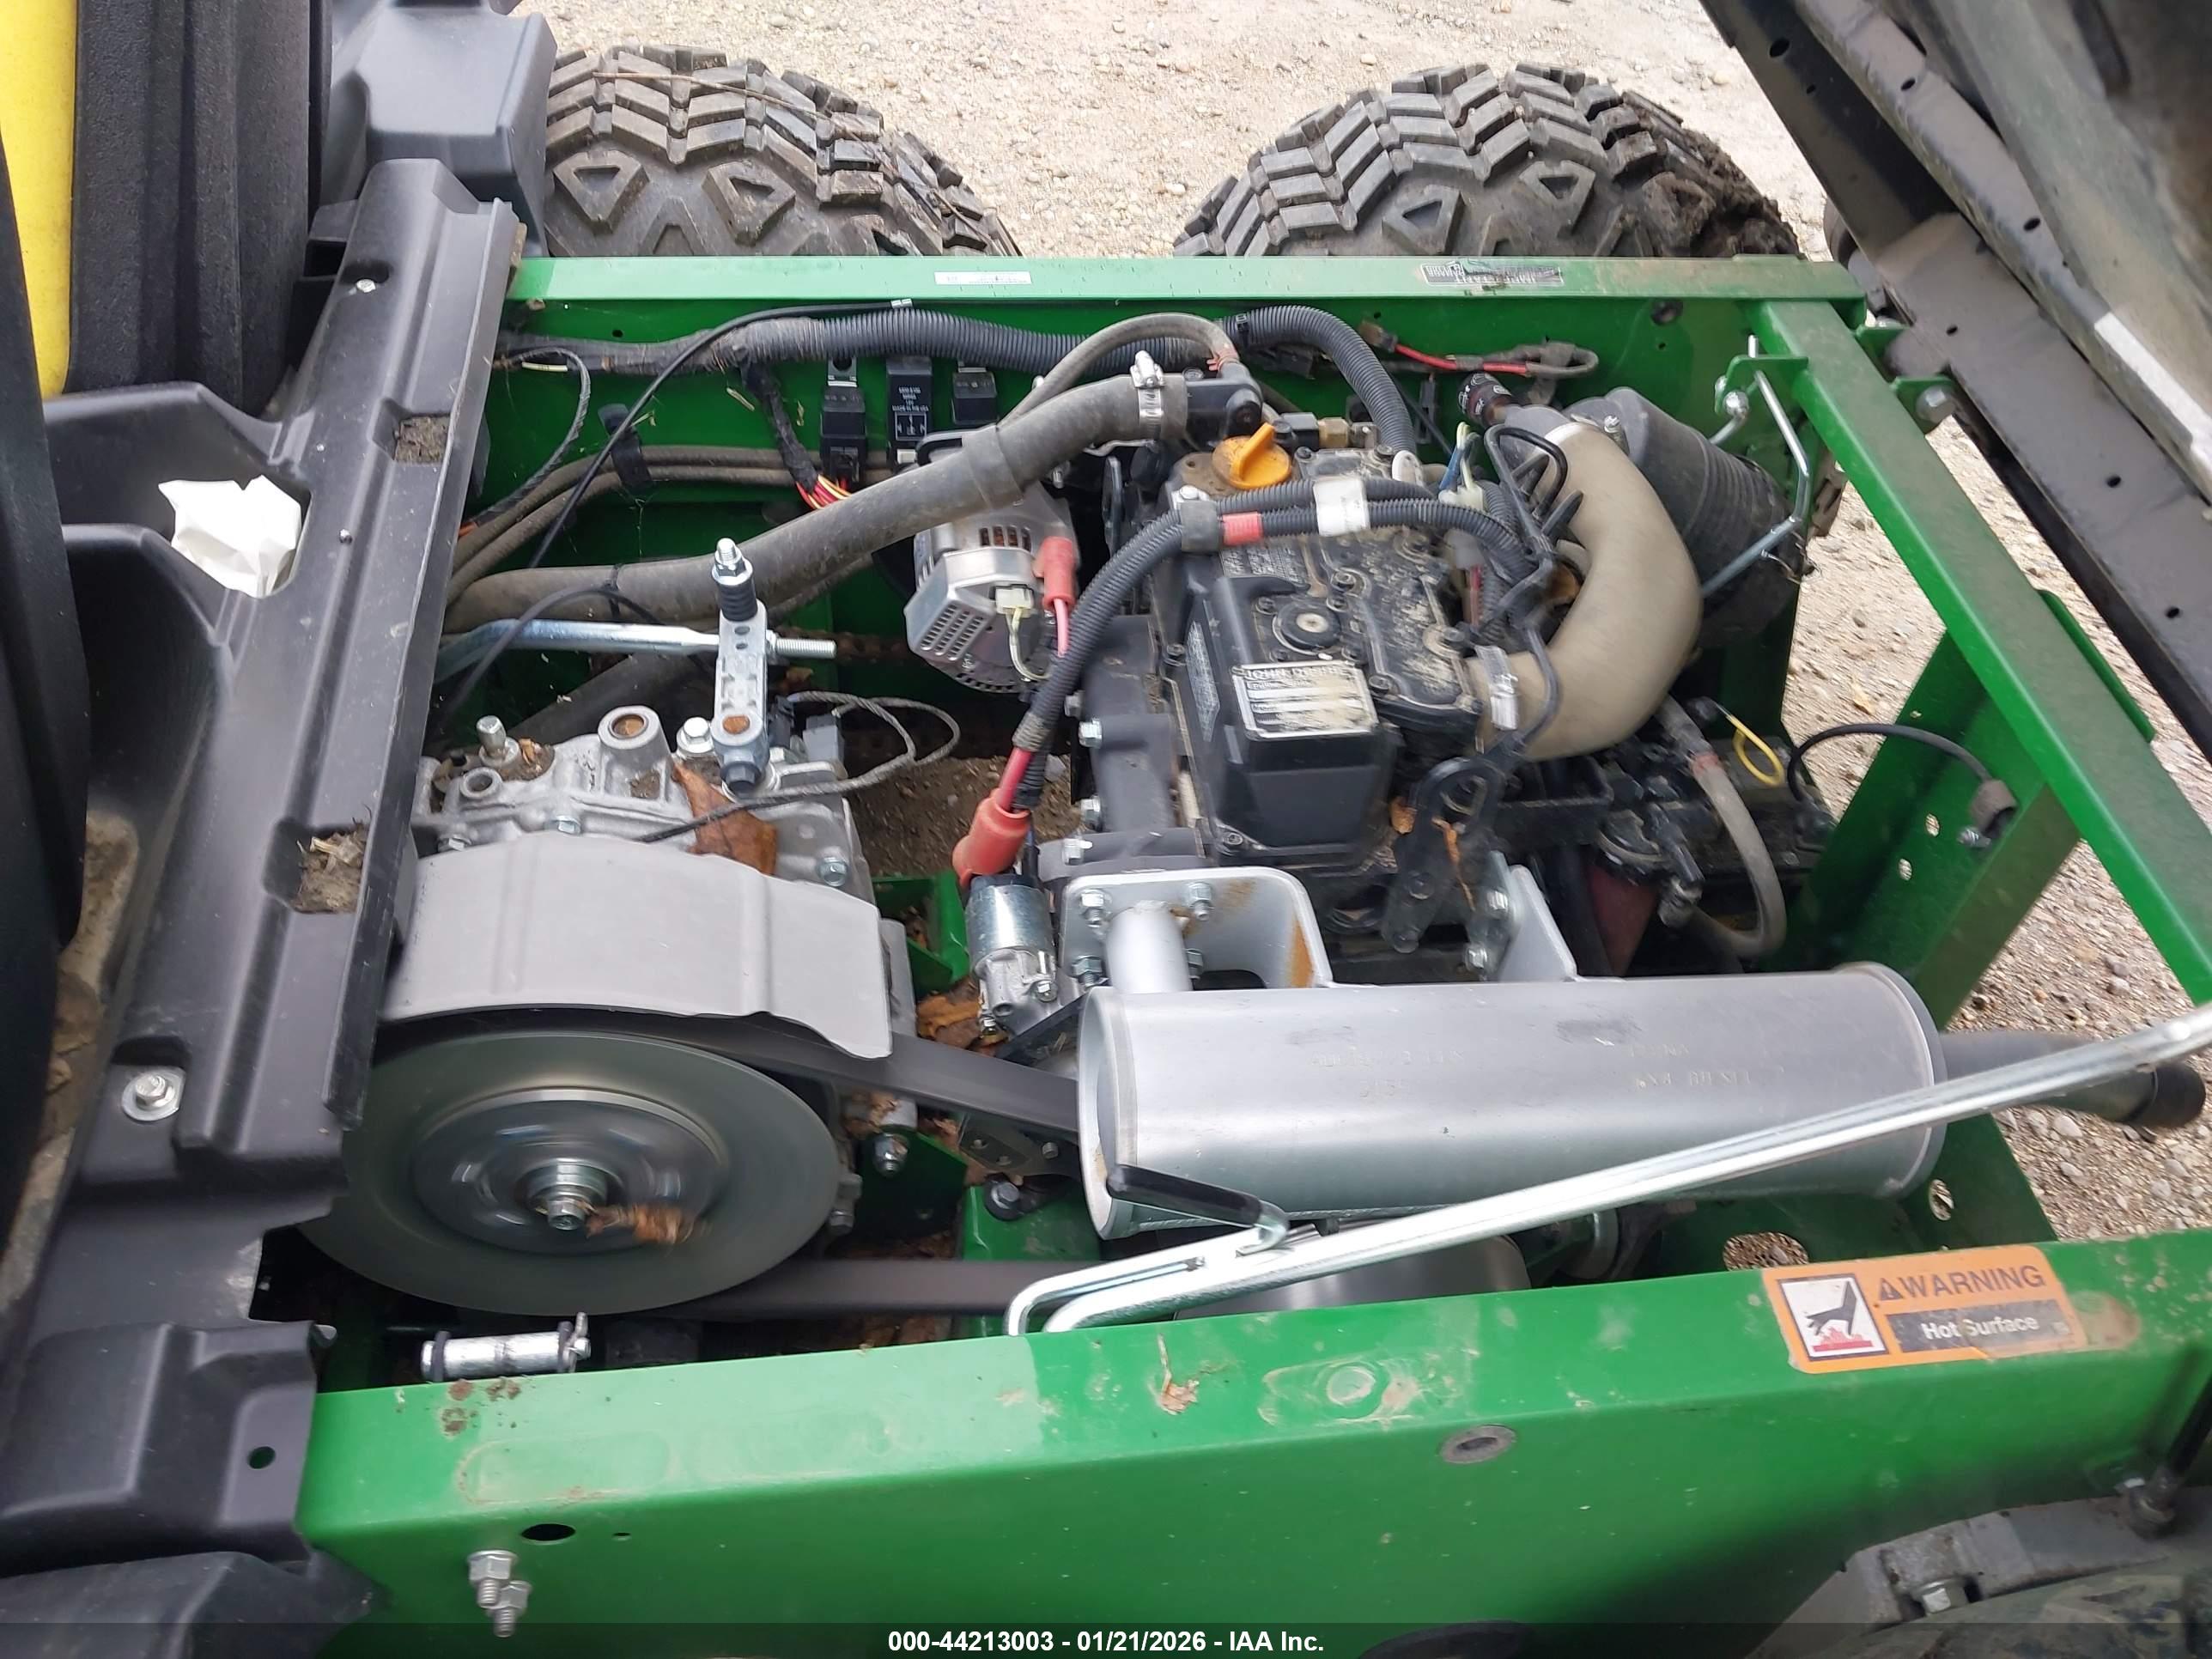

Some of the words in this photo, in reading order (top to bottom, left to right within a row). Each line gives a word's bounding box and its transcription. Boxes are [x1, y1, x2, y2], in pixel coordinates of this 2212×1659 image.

[1898, 1265, 2045, 1297] WARNING
[1921, 1322, 1962, 1340] Hot
[1963, 1316, 2040, 1336] Surface
